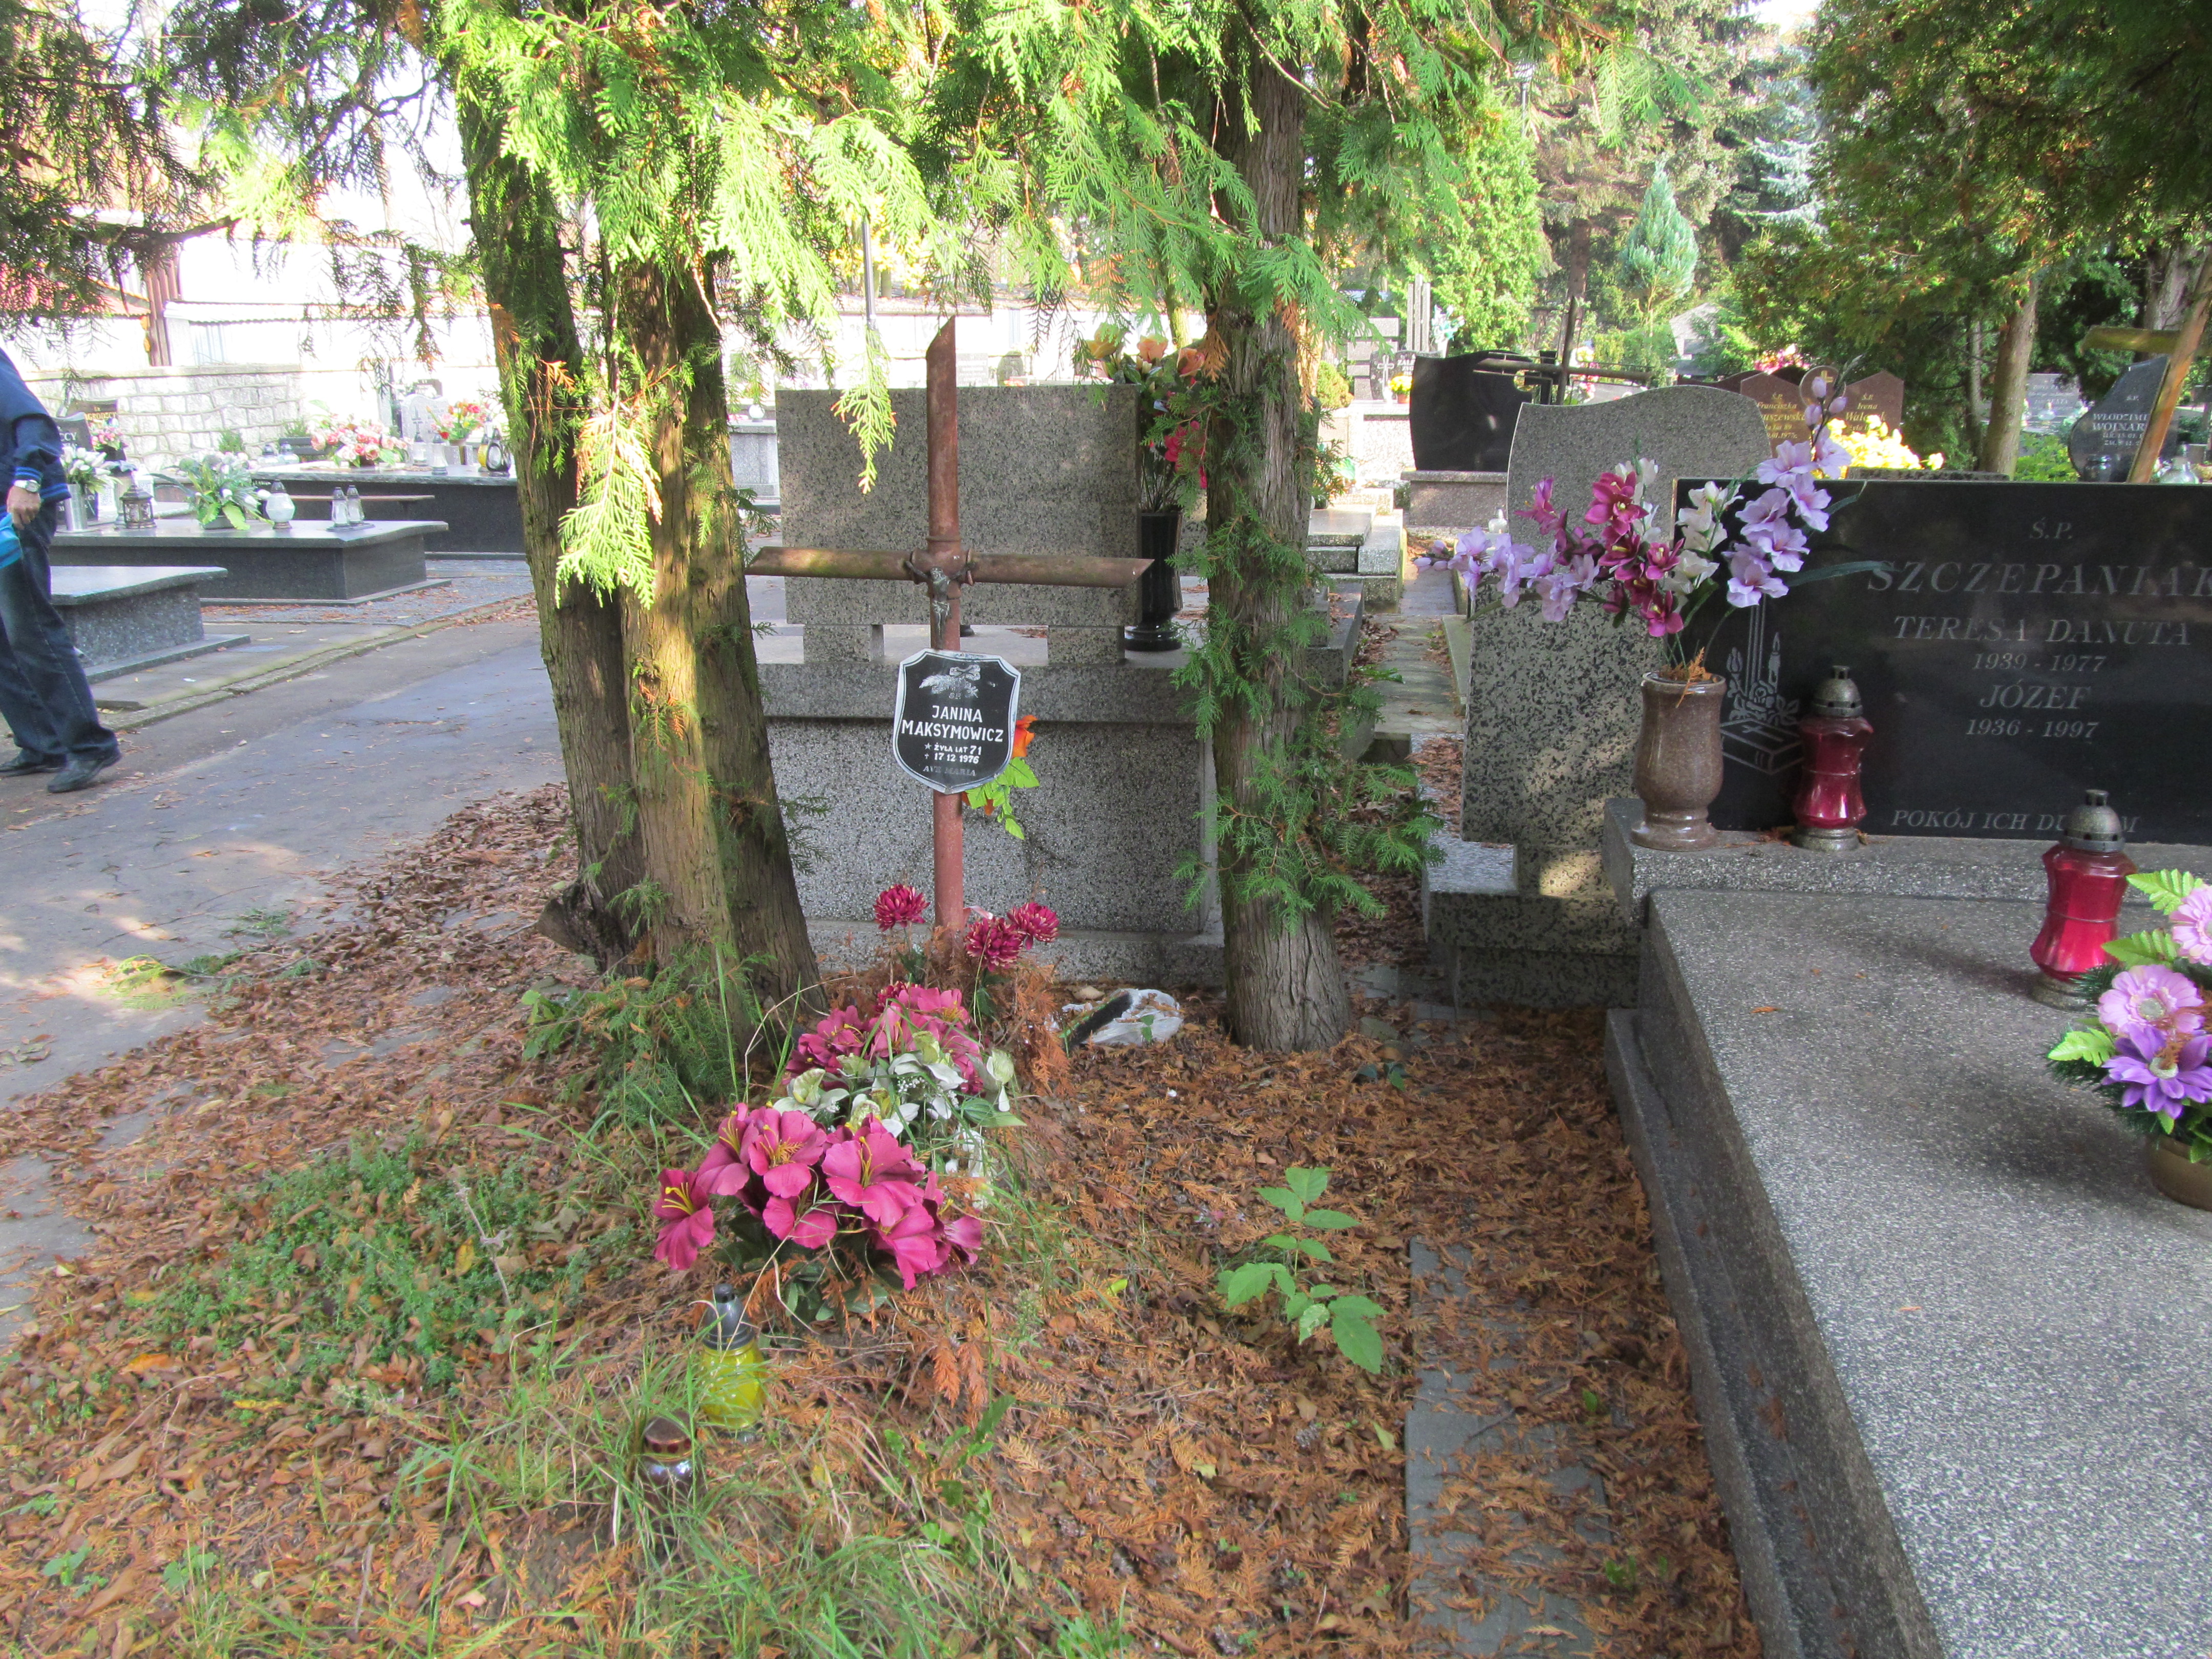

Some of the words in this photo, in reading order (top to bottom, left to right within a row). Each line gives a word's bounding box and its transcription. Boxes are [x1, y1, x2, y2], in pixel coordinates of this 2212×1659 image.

[1894, 615, 2028, 641] TERESA
[2045, 619, 2191, 646] DANUTA
[1972, 652, 2028, 670] 1939
[2049, 654, 2107, 672] 1977
[1980, 678, 2092, 710] JÓZEF
[932, 705, 983, 723] JANINA
[901, 719, 1004, 742] MAKSYMOWICZ
[1965, 718, 2021, 736] 1936
[2041, 720, 2099, 739] 1997
[934, 742, 953, 753] ŻYŁA
[970, 745, 982, 755] 71
[934, 752, 945, 760] 17
[947, 754, 956, 762] 12
[959, 755, 980, 764] 1976
[1890, 807, 1977, 828] POKÓJ
[1982, 812, 2030, 830] ICH
